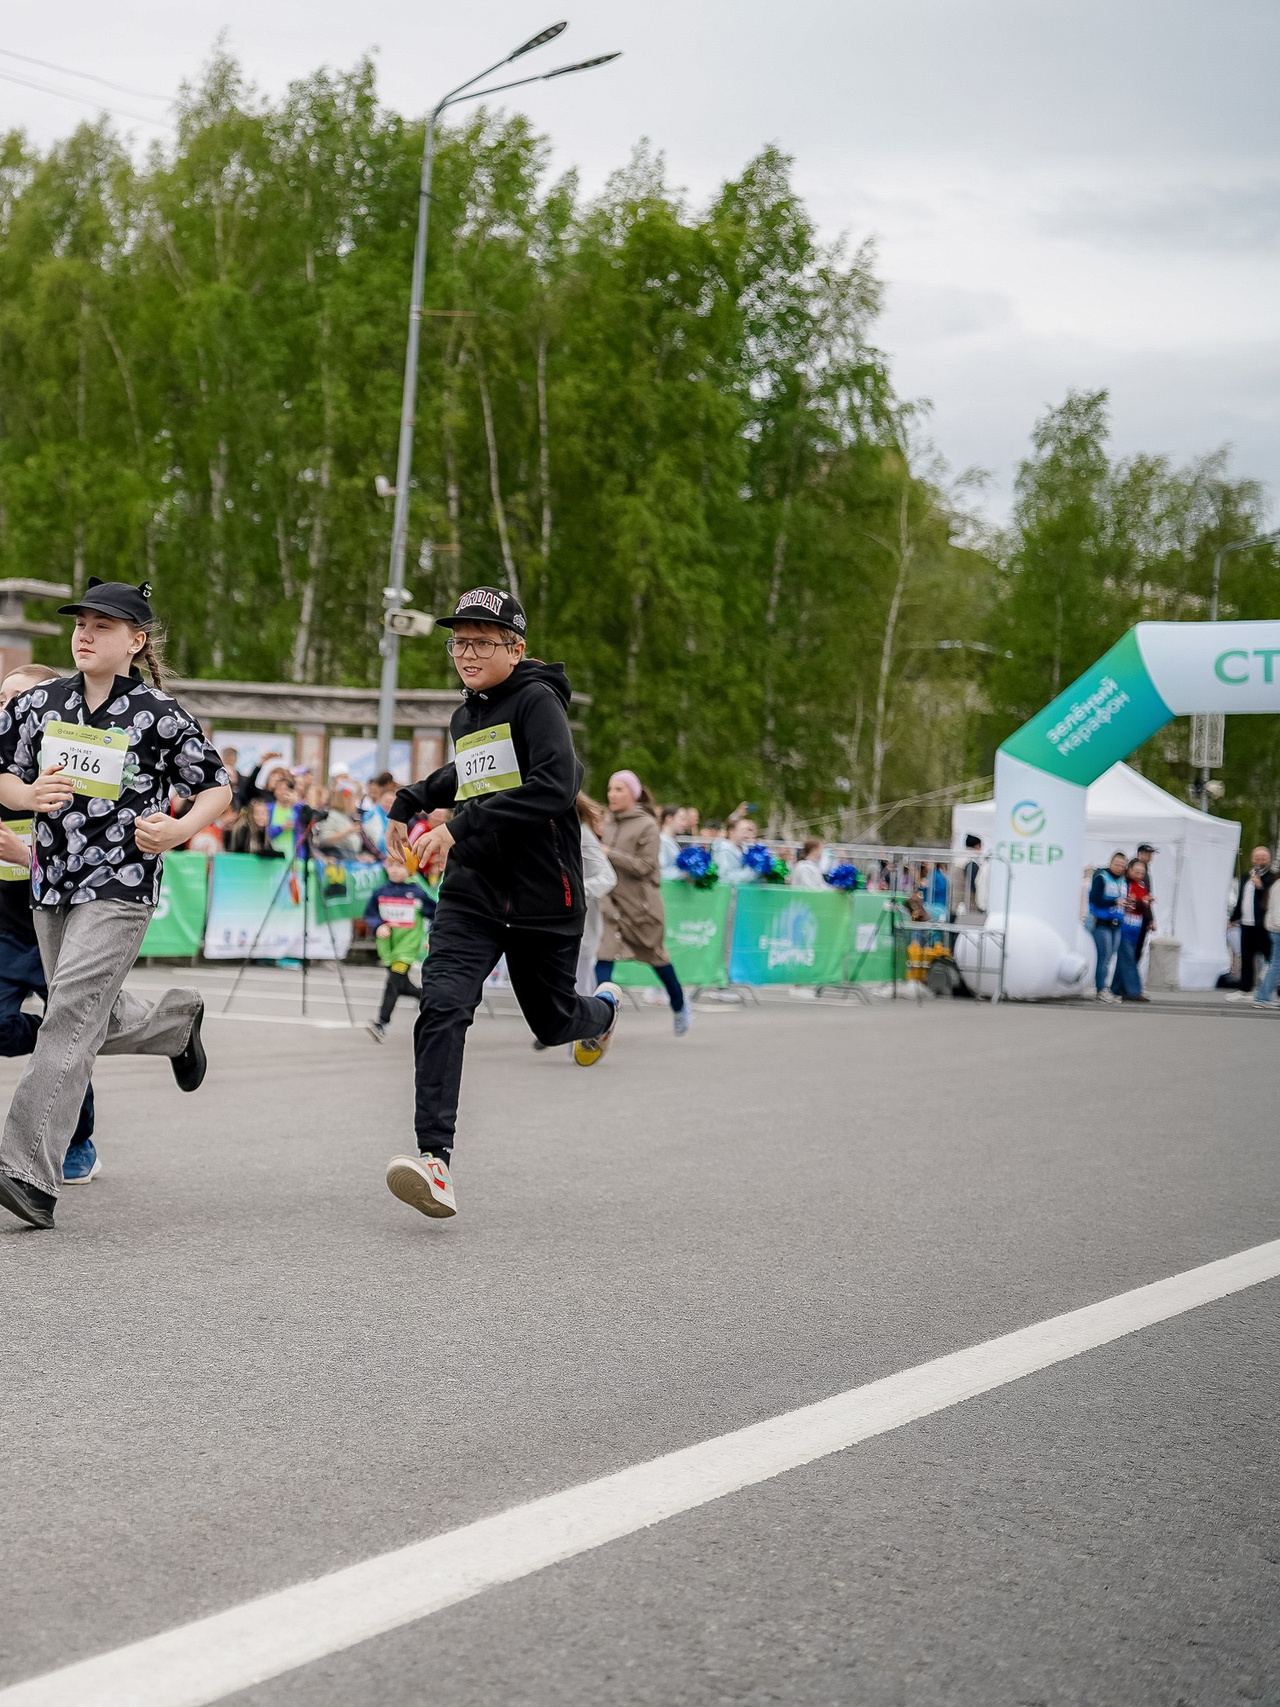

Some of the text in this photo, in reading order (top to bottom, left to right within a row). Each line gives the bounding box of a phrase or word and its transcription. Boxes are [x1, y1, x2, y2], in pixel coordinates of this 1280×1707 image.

[455, 590, 503, 616] JORDAN
[1214, 650, 1280, 685] СТ
[1046, 675, 1118, 744] зелёный
[1058, 691, 1131, 757] марафон
[58, 752, 101, 775] 3166
[465, 755, 497, 776] 3172
[71, 778, 87, 790] 00м
[995, 841, 1064, 865] СБЕР
